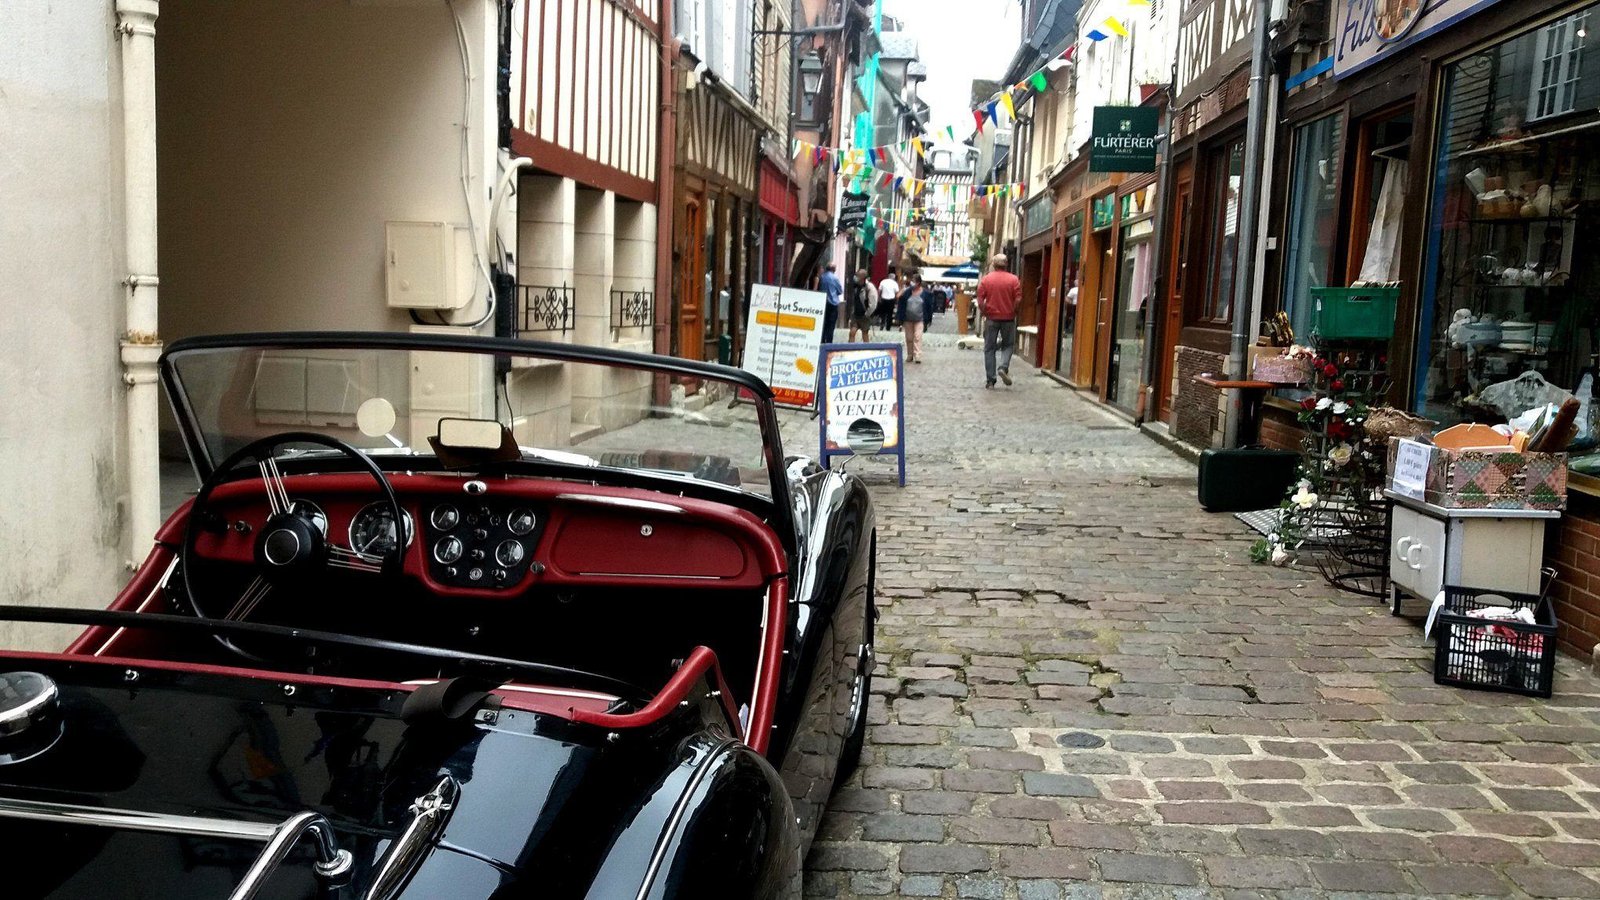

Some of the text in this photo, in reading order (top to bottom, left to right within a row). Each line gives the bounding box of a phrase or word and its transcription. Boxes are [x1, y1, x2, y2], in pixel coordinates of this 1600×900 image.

[1094, 136, 1154, 148] FURTERER
[792, 301, 823, 315] Services
[832, 357, 891, 376] BROCANTE
[833, 389, 889, 402] ACHAT
[835, 404, 889, 416] VENTE
